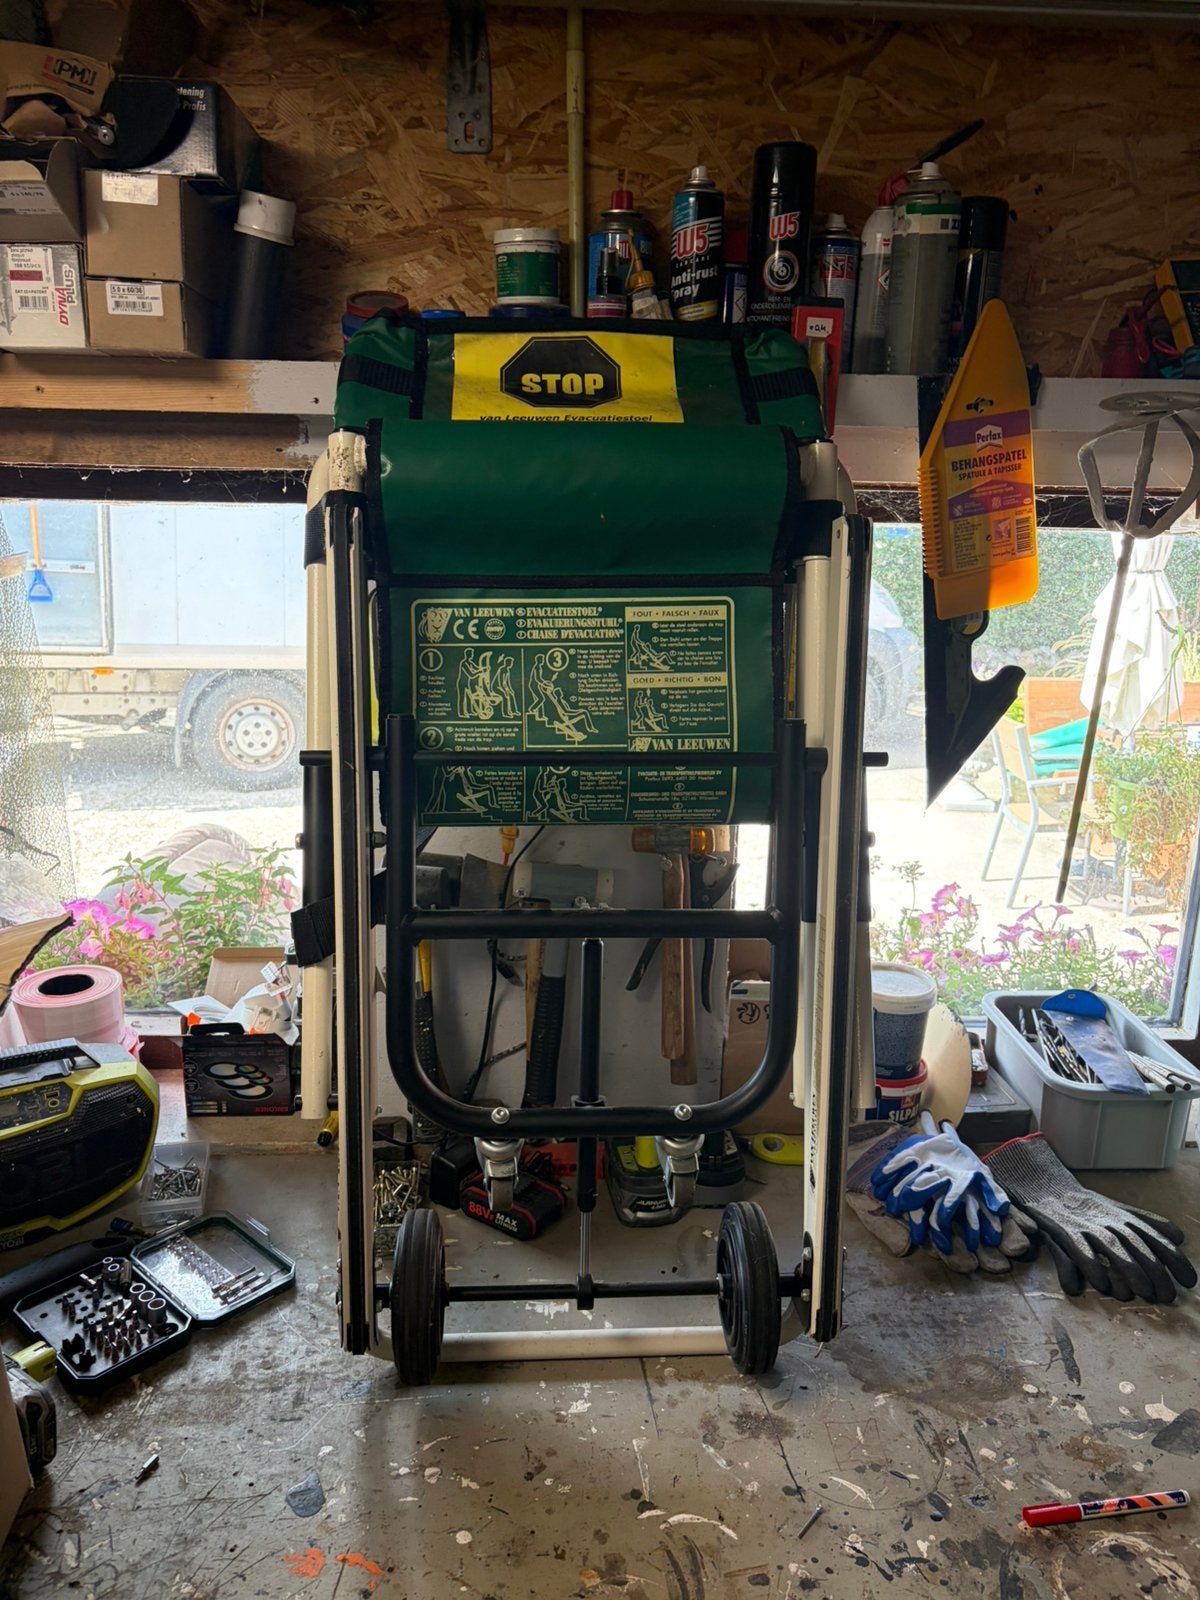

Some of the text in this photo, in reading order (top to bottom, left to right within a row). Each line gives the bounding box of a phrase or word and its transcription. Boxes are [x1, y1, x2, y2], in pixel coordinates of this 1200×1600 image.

[770, 212, 800, 240] W5
[677, 223, 710, 259] W5
[65, 269, 75, 304] PLUS
[671, 264, 718, 288] Anti-rust
[55, 288, 71, 326] DYNA
[521, 373, 604, 395] STOP
[976, 430, 1002, 443] Perfax
[952, 449, 1027, 472] BEHANGSPATEL
[958, 470, 986, 480] SPATULE
[994, 463, 1022, 474] TAPISSER
[453, 607, 514, 617] VAN LEEUWEN
[453, 619, 479, 640] CE
[526, 629, 558, 640] CHAISE
[652, 738, 731, 750] VAN LEEUWEN
[496, 1212, 517, 1226] MAX
